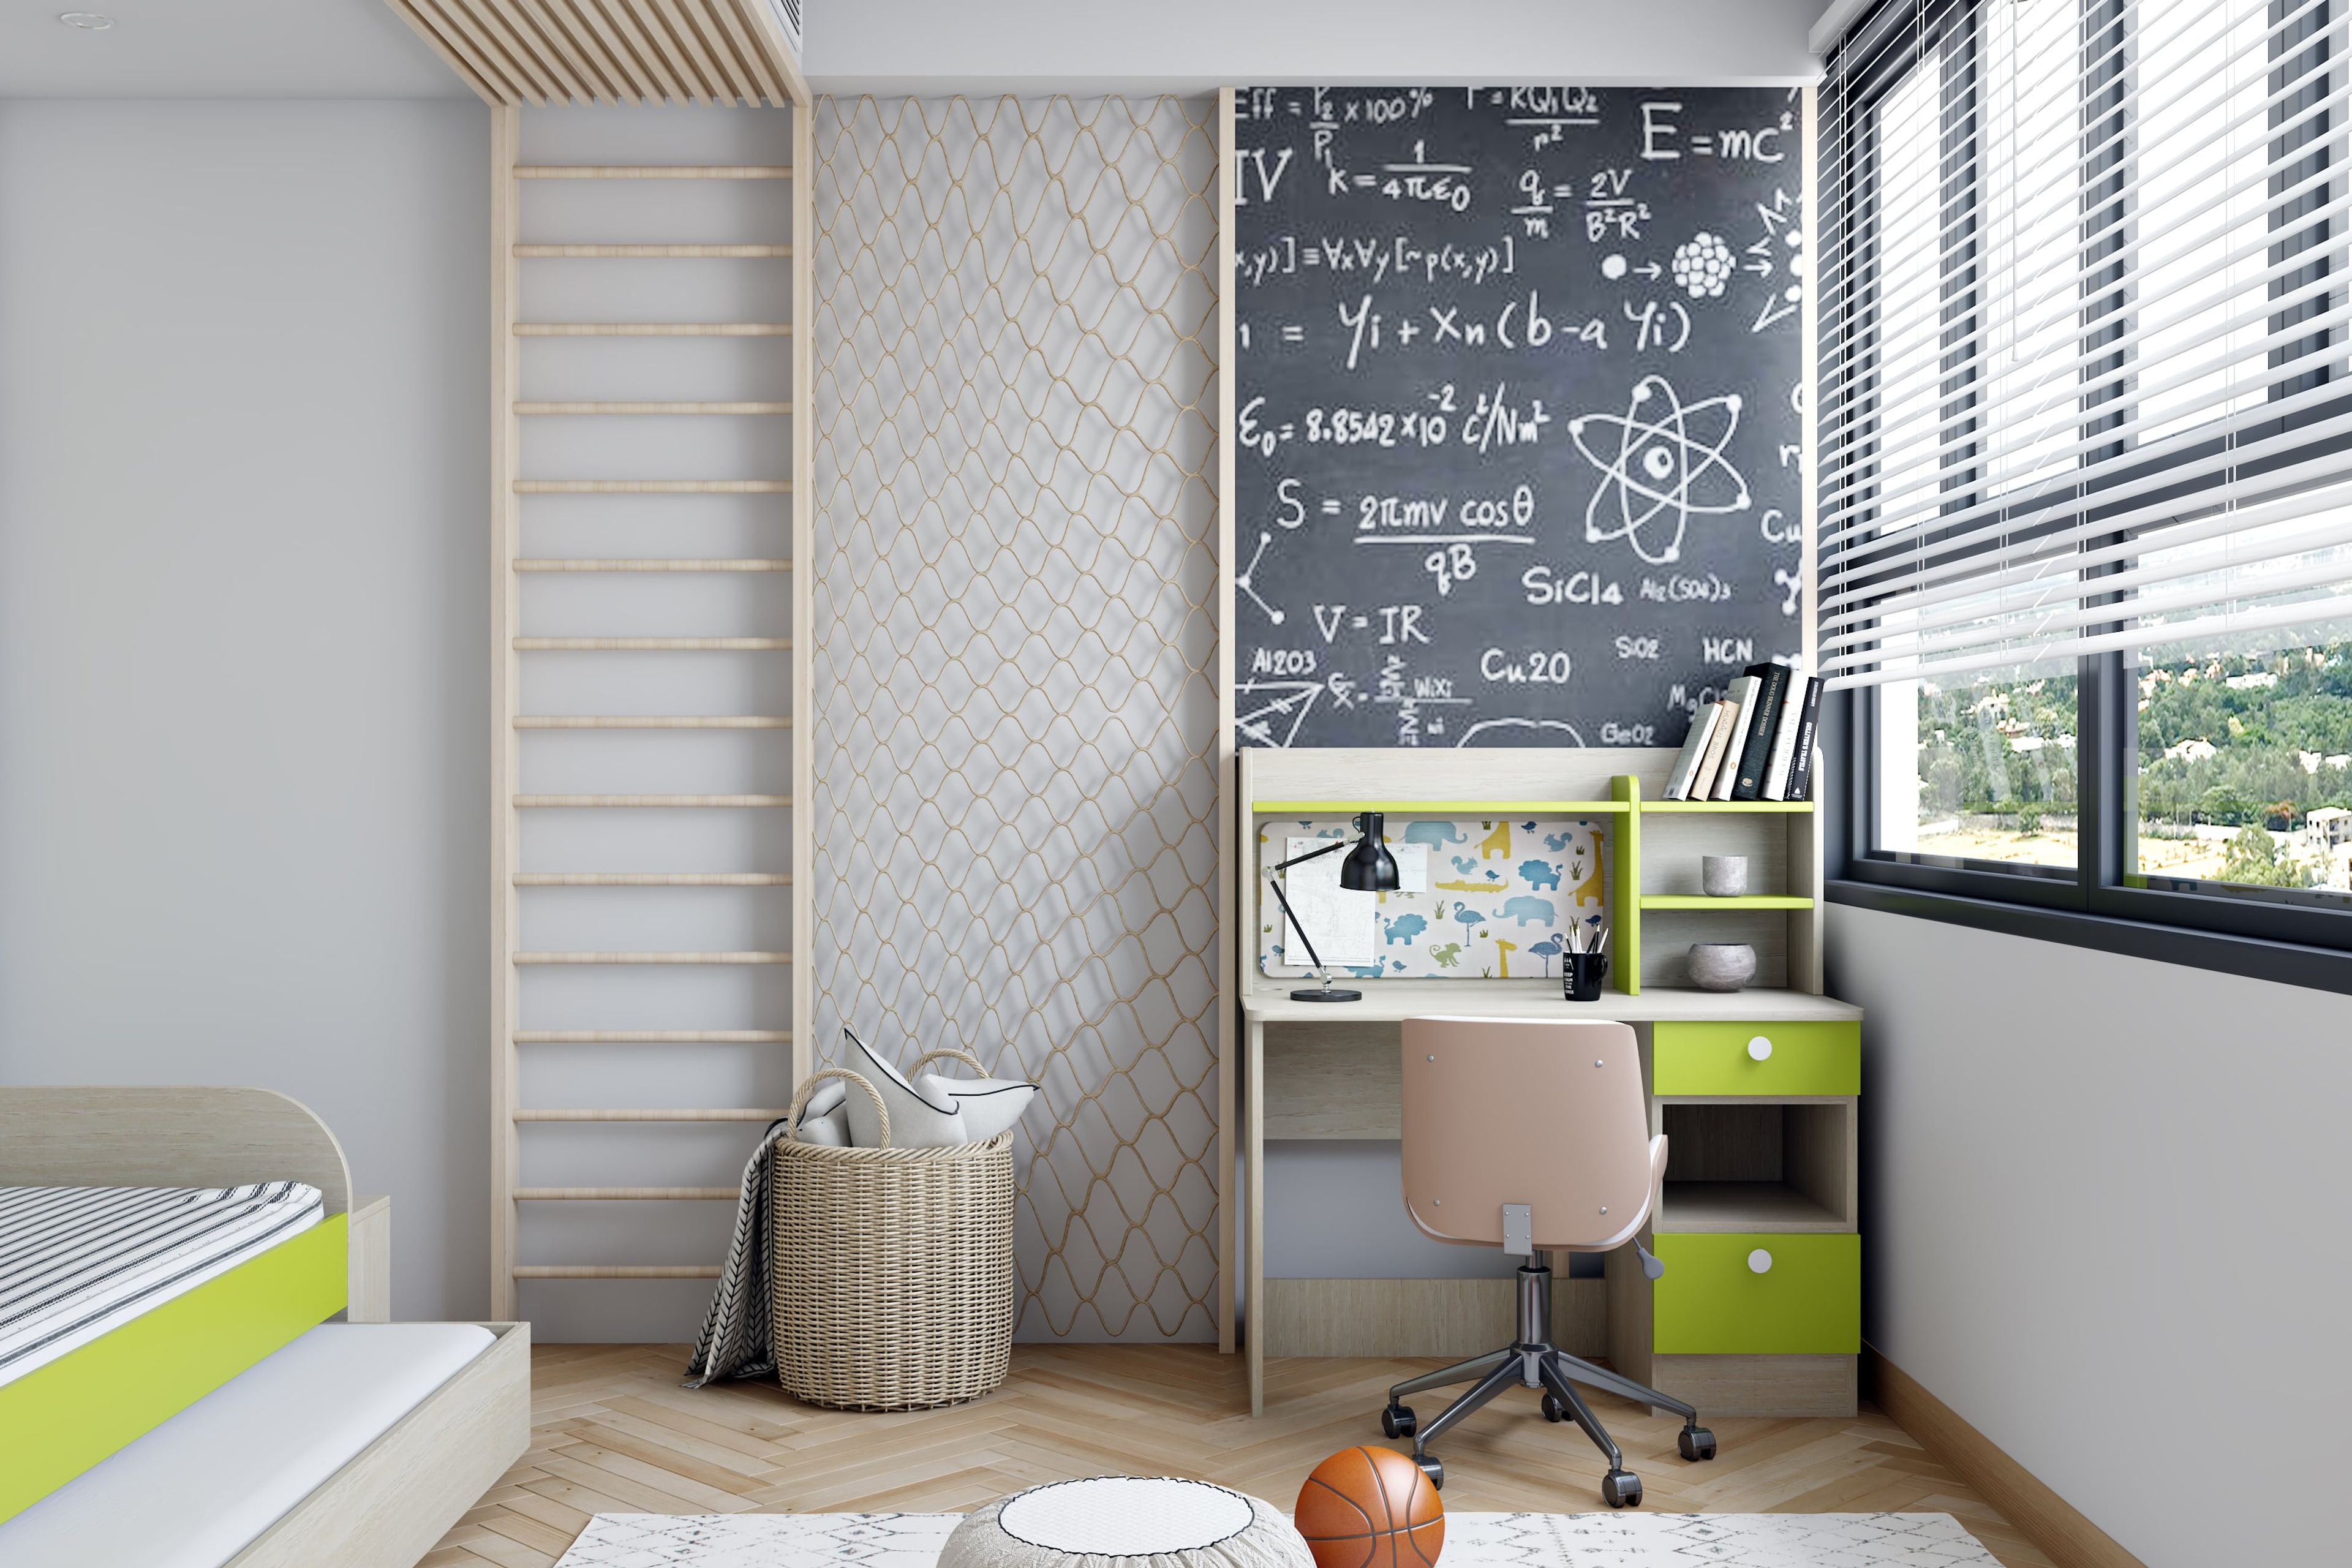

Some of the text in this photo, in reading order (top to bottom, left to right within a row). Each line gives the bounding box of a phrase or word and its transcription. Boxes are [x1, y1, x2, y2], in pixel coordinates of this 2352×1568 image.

[1702, 637, 1753, 665] HCN
[1768, 680, 1777, 696] DOUG
[1762, 695, 1774, 717] SKINNER
[1757, 715, 1768, 737] DOSSIER
